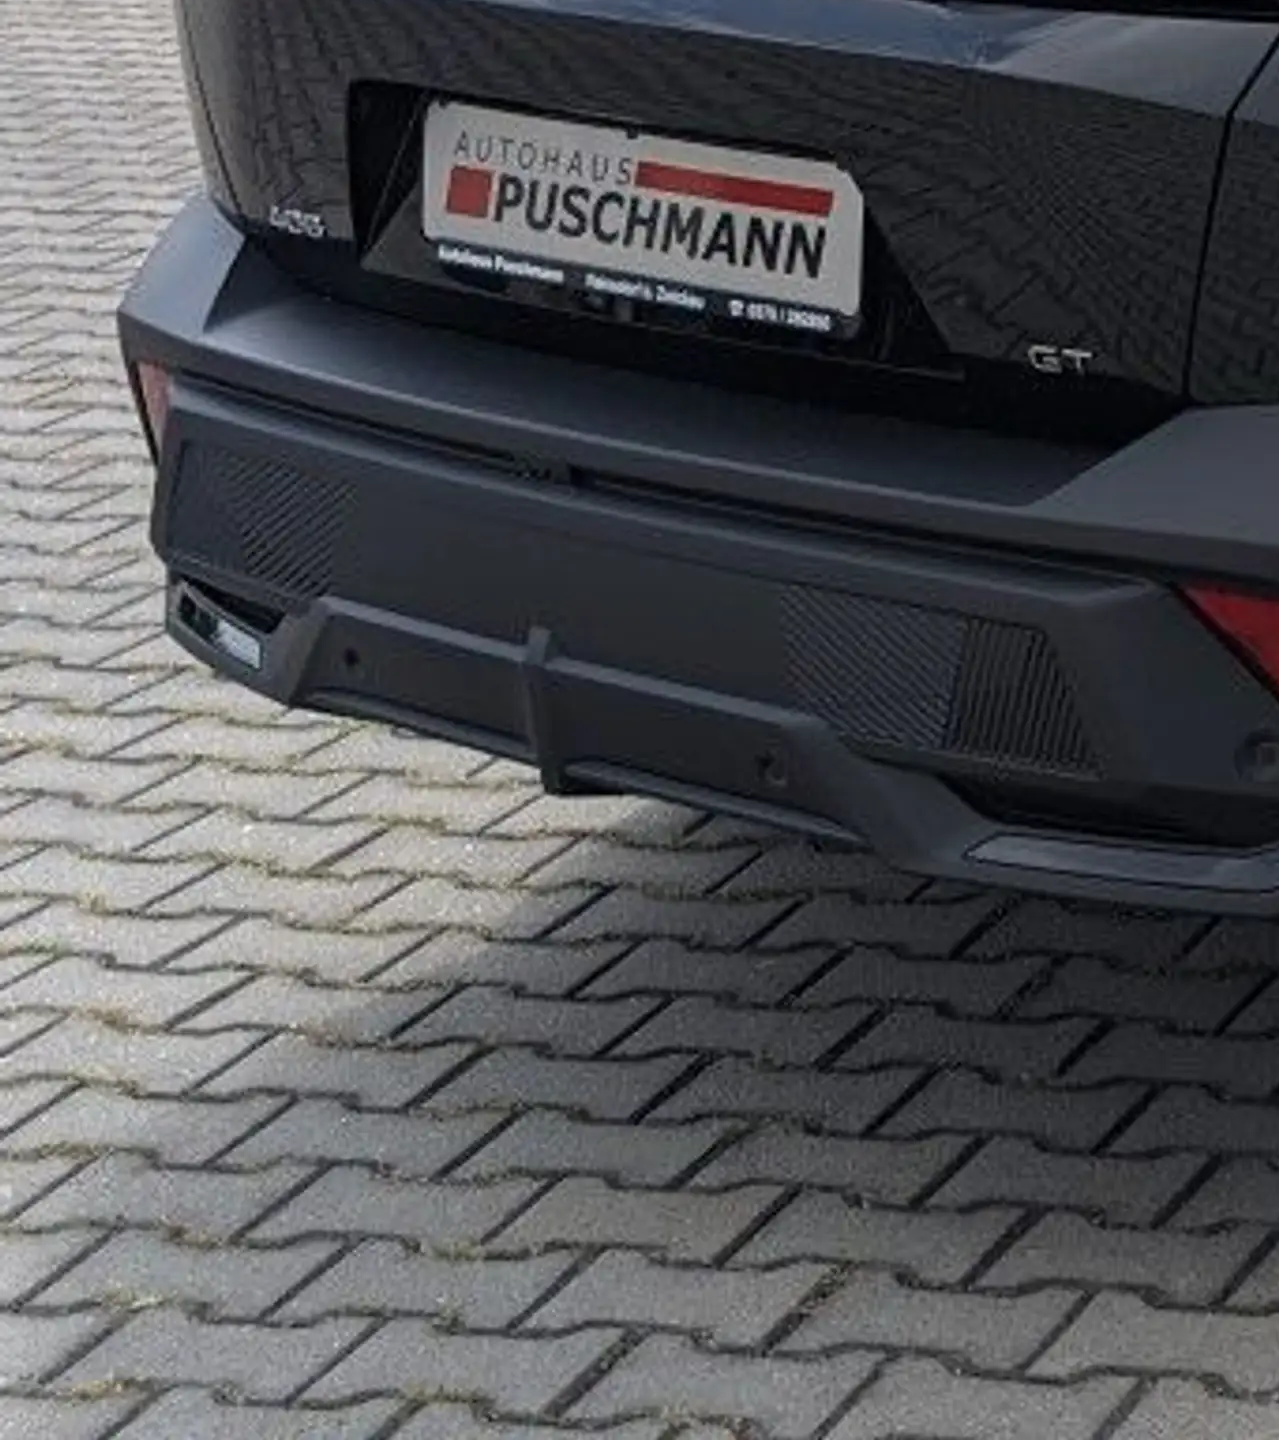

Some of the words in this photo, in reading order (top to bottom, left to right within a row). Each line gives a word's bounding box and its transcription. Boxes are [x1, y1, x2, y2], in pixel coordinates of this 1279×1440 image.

[453, 129, 634, 187] AUTOHAUS
[493, 172, 828, 279] PUSCHMANN
[1027, 344, 1094, 376] GT
